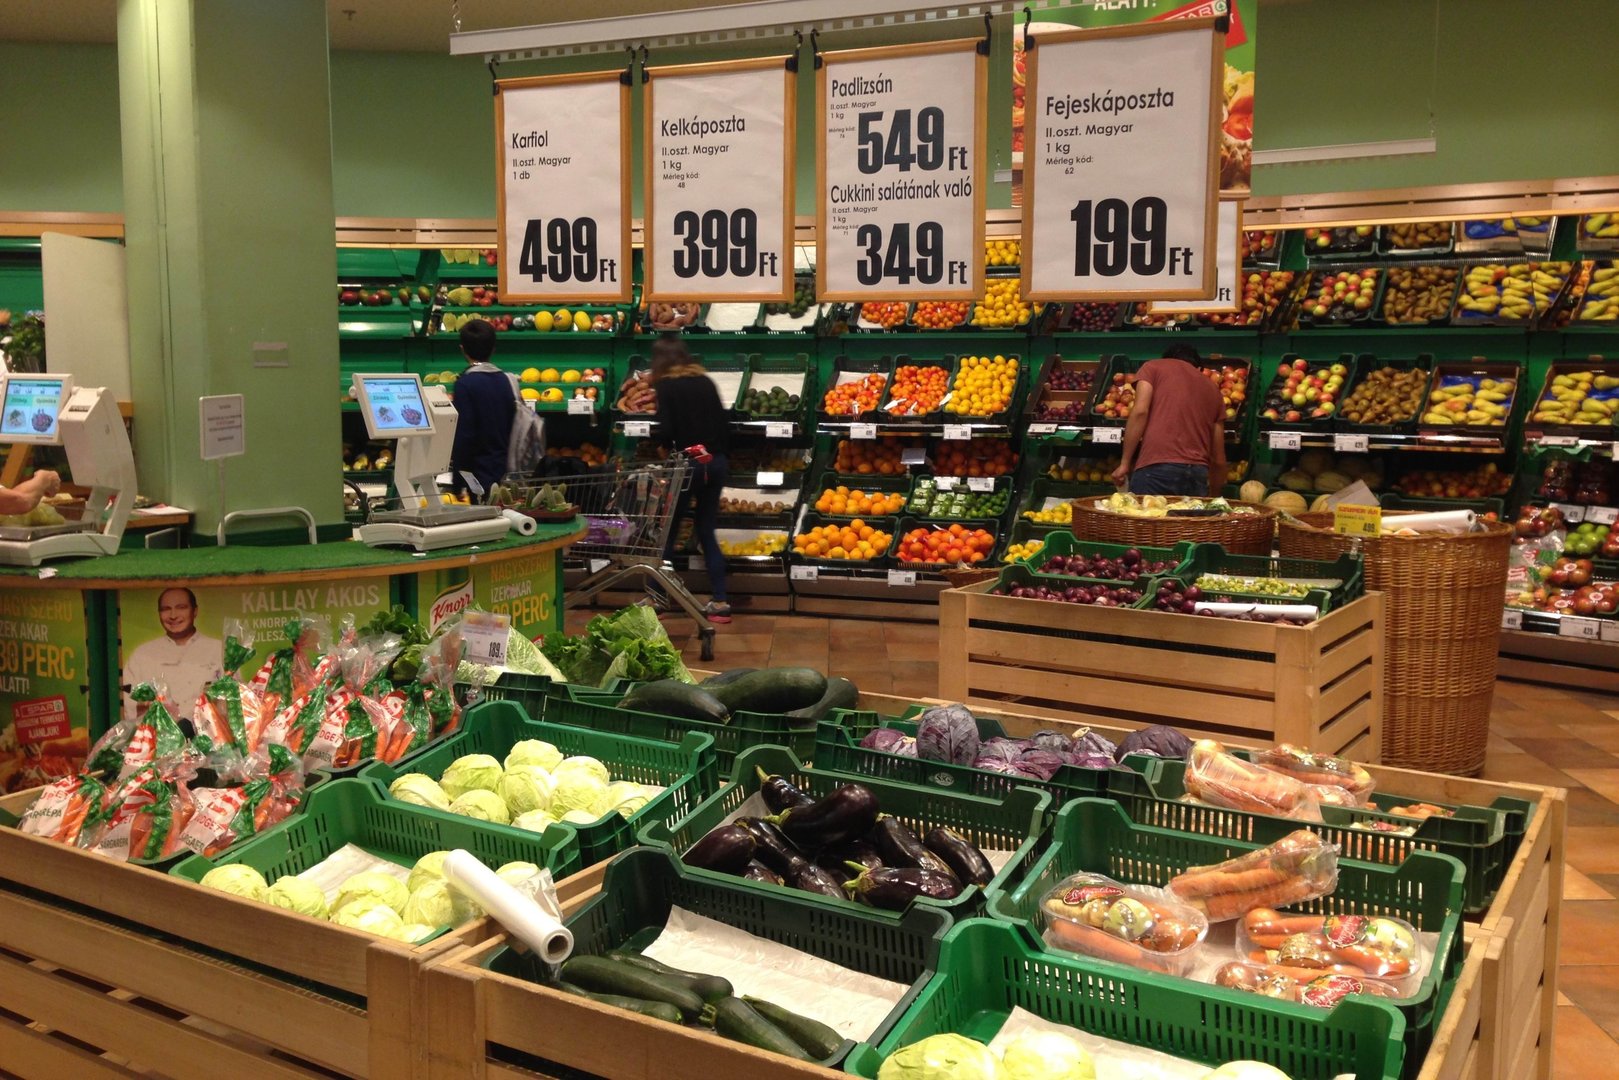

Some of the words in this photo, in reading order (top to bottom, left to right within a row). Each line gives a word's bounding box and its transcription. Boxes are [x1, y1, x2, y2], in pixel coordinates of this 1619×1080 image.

[832, 73, 893, 98] Padlizsán
[1046, 87, 1174, 120] Fejeskáposzta
[661, 115, 746, 138] Kelkáposzta
[1045, 126, 1082, 137] II.oszt.
[1085, 124, 1134, 136] Magyar
[512, 130, 548, 149] Karfiol
[692, 145, 729, 156] Magyar
[857, 107, 945, 175] 549
[949, 146, 968, 171] Ft
[1046, 143, 1051, 153] 1
[1055, 143, 1071, 155] kg
[538, 157, 571, 167] Magyar
[669, 160, 682, 171] kg
[1045, 157, 1074, 166] Mérleg
[519, 171, 530, 180] db
[831, 183, 875, 204] Cukkini
[877, 178, 940, 201] salátának
[944, 176, 972, 198] való
[673, 208, 757, 279] 399
[759, 252, 778, 277] Ft
[1070, 196, 1168, 277] 199
[1169, 247, 1194, 276] Ft
[519, 217, 597, 283] 499
[600, 259, 616, 283] Ft
[856, 222, 944, 286] 349
[948, 261, 967, 284] Ft
[1219, 288, 1231, 301] Ft
[242, 587, 318, 614] KÁLLAY
[326, 583, 381, 608] ÁKOS
[433, 593, 471, 625] Knorr
[512, 592, 549, 628] PERC
[22, 641, 75, 680] PERC
[319, 729, 342, 744] DGET
